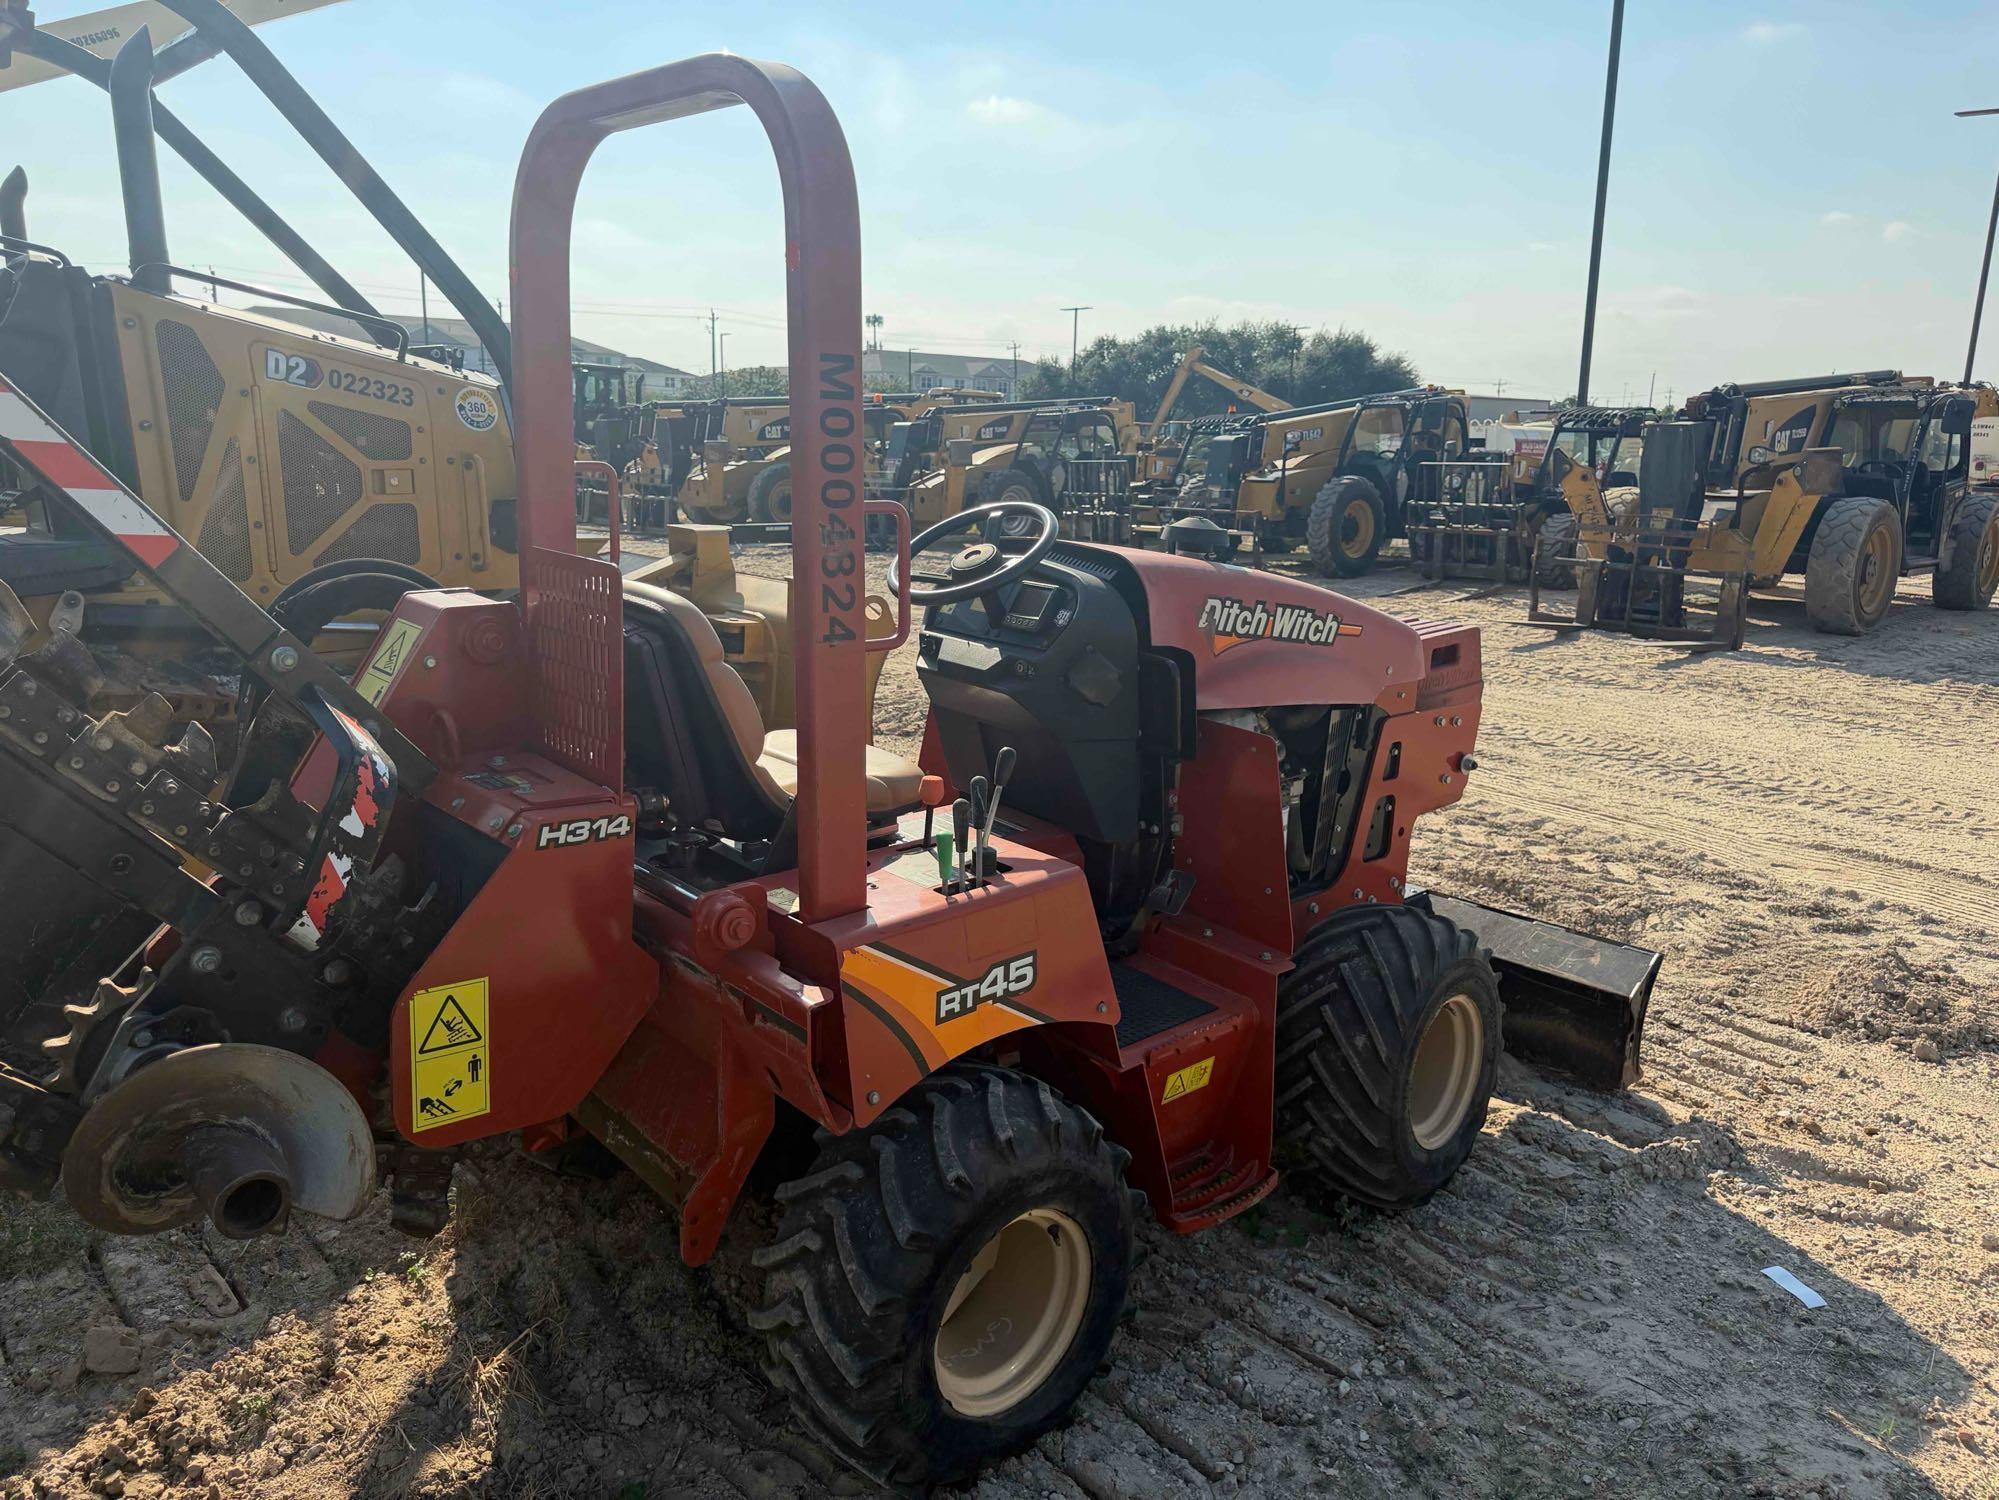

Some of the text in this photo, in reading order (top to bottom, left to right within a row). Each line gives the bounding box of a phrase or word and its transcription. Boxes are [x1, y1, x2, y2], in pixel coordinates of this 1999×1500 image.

[267, 350, 415, 408] D2 022323
[467, 401, 487, 414] 360
[765, 425, 781, 439] CAT
[981, 426, 994, 439] CAT
[1775, 430, 1791, 452] CAT
[1272, 606, 1339, 644] Witch
[539, 815, 631, 847] H314
[940, 955, 1034, 1018] RT45
